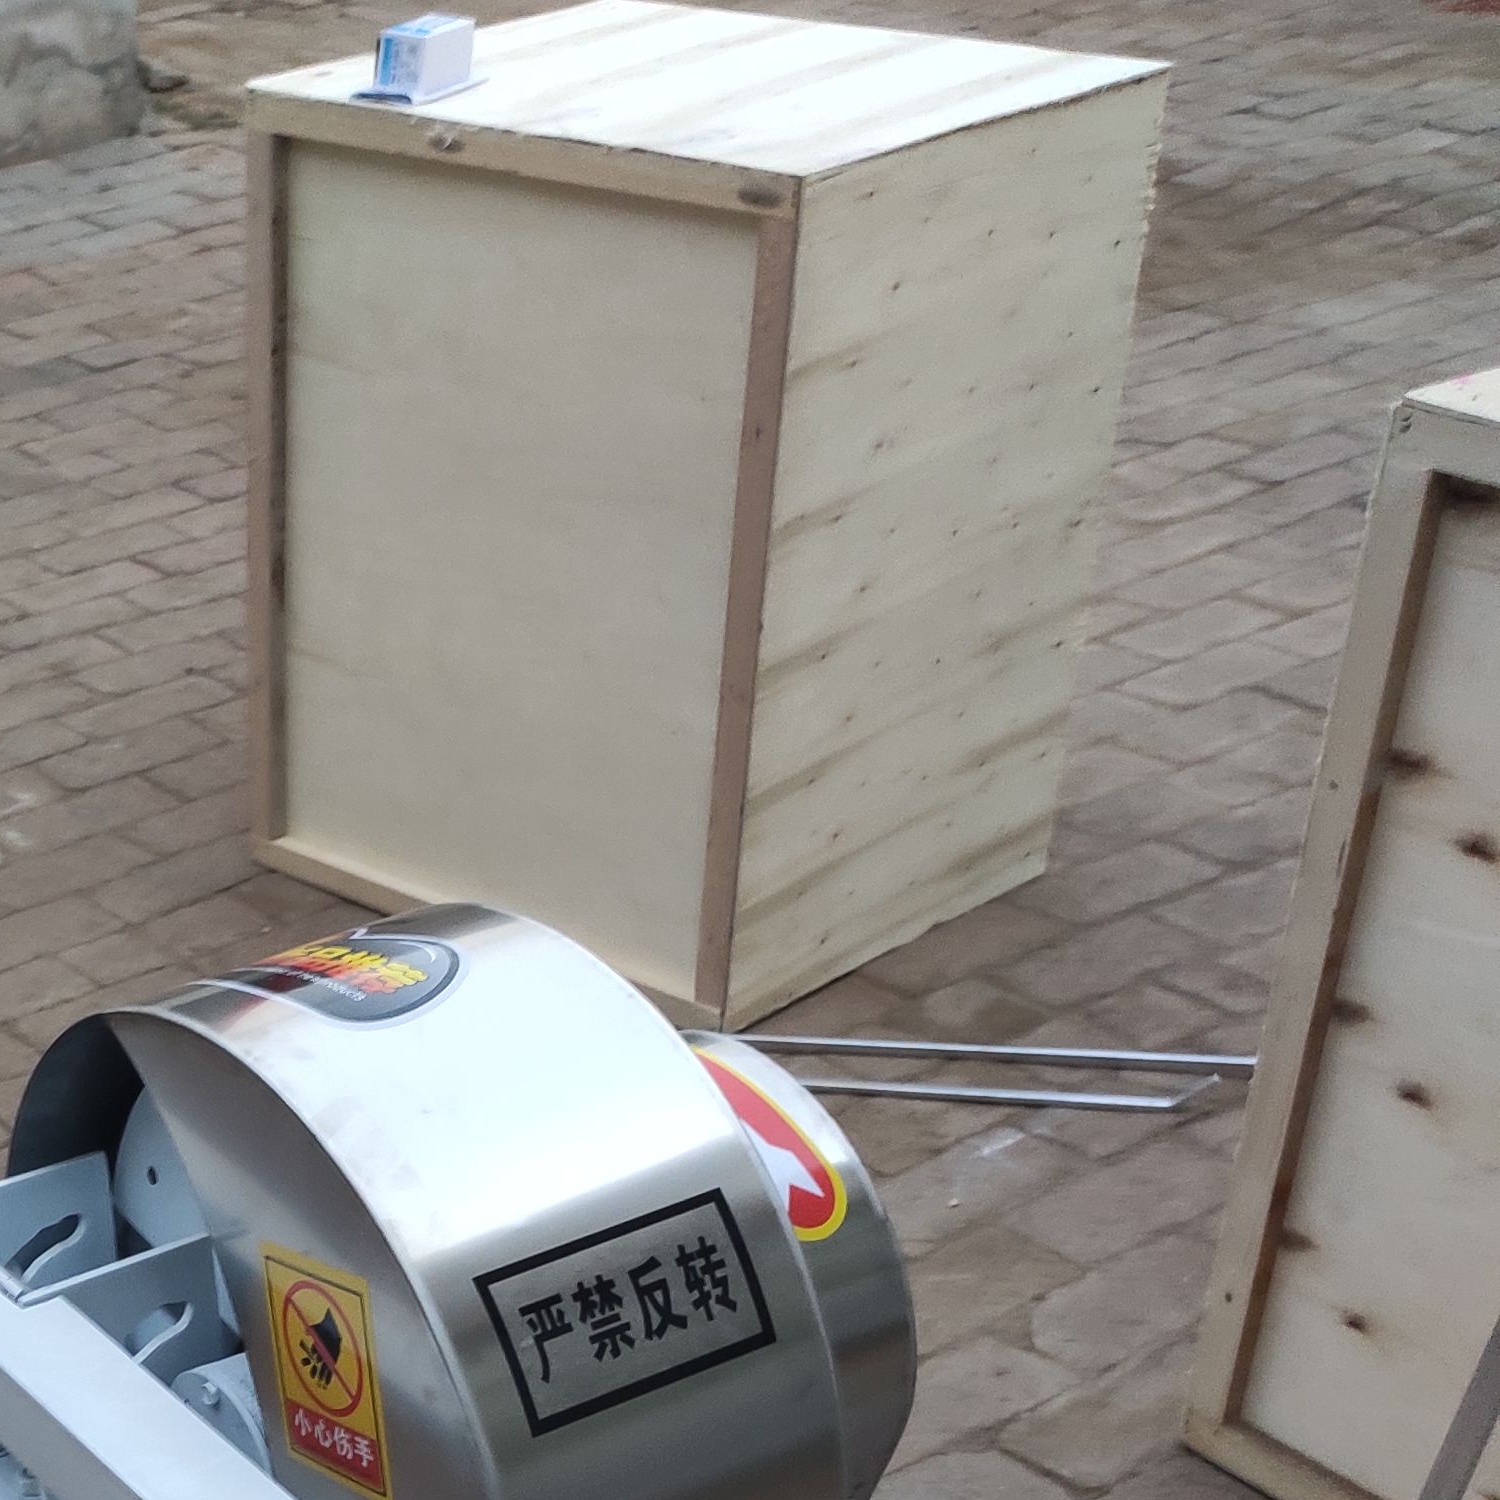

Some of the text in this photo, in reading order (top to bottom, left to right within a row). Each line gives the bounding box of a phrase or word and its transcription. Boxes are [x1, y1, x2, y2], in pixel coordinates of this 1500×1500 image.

[518, 1236, 737, 1383] 严禁反转
[294, 1408, 374, 1467] 小心伤手
